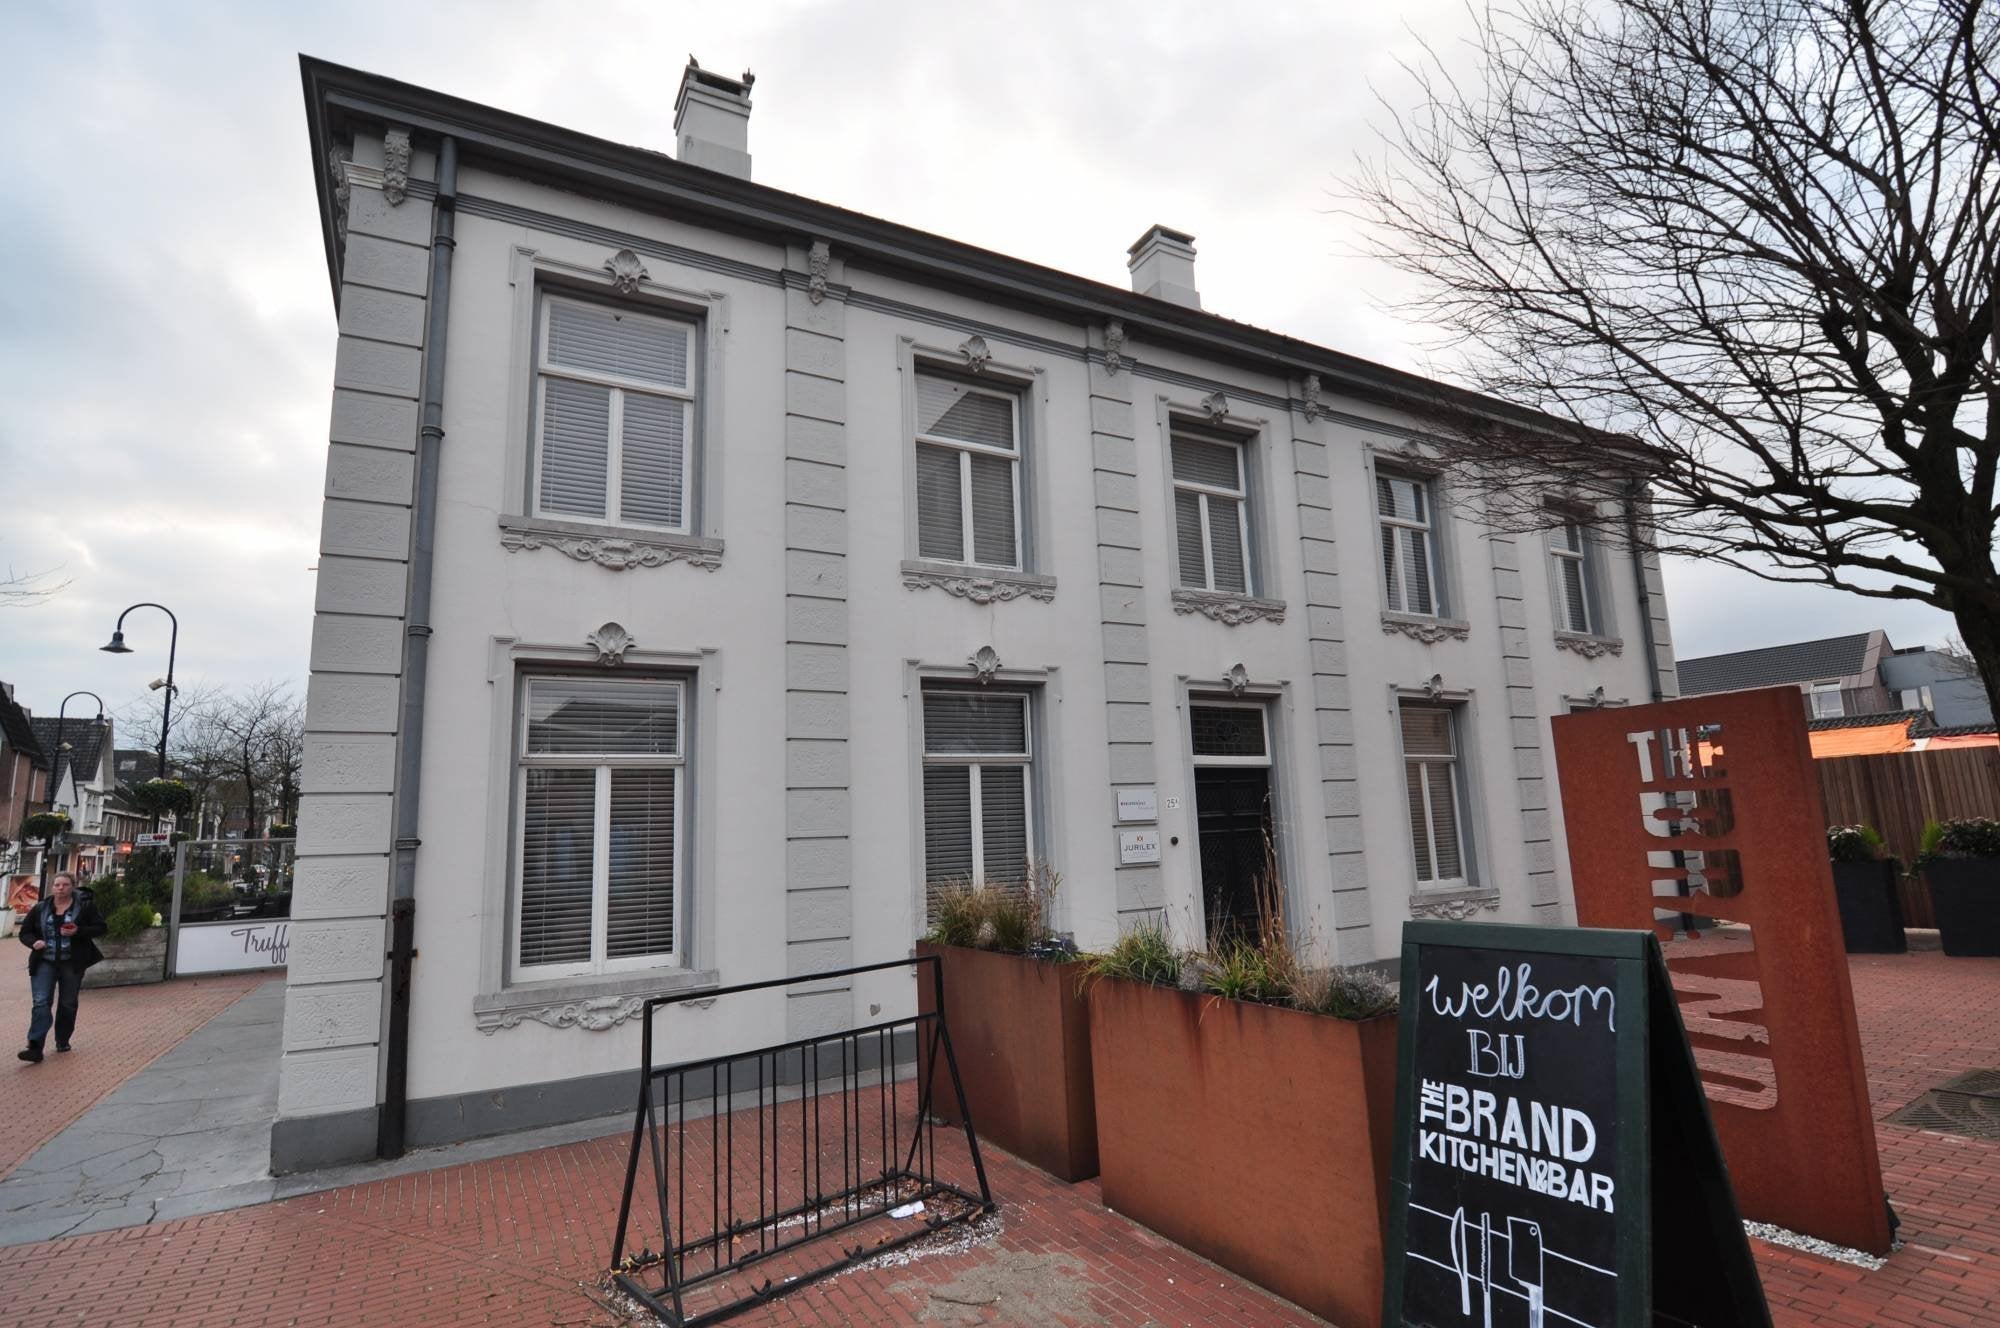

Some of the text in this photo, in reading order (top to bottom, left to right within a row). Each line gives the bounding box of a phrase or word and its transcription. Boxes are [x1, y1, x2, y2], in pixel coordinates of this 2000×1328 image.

[1626, 723, 1728, 783] THE
[1124, 843, 1156, 852] JURILEX
[230, 924, 290, 964] Truff
[1638, 787, 1778, 1111] BRAND
[1425, 963, 1616, 1033] welkom
[1419, 1078, 1445, 1123] THE
[1445, 1083, 1597, 1163] BRAND
